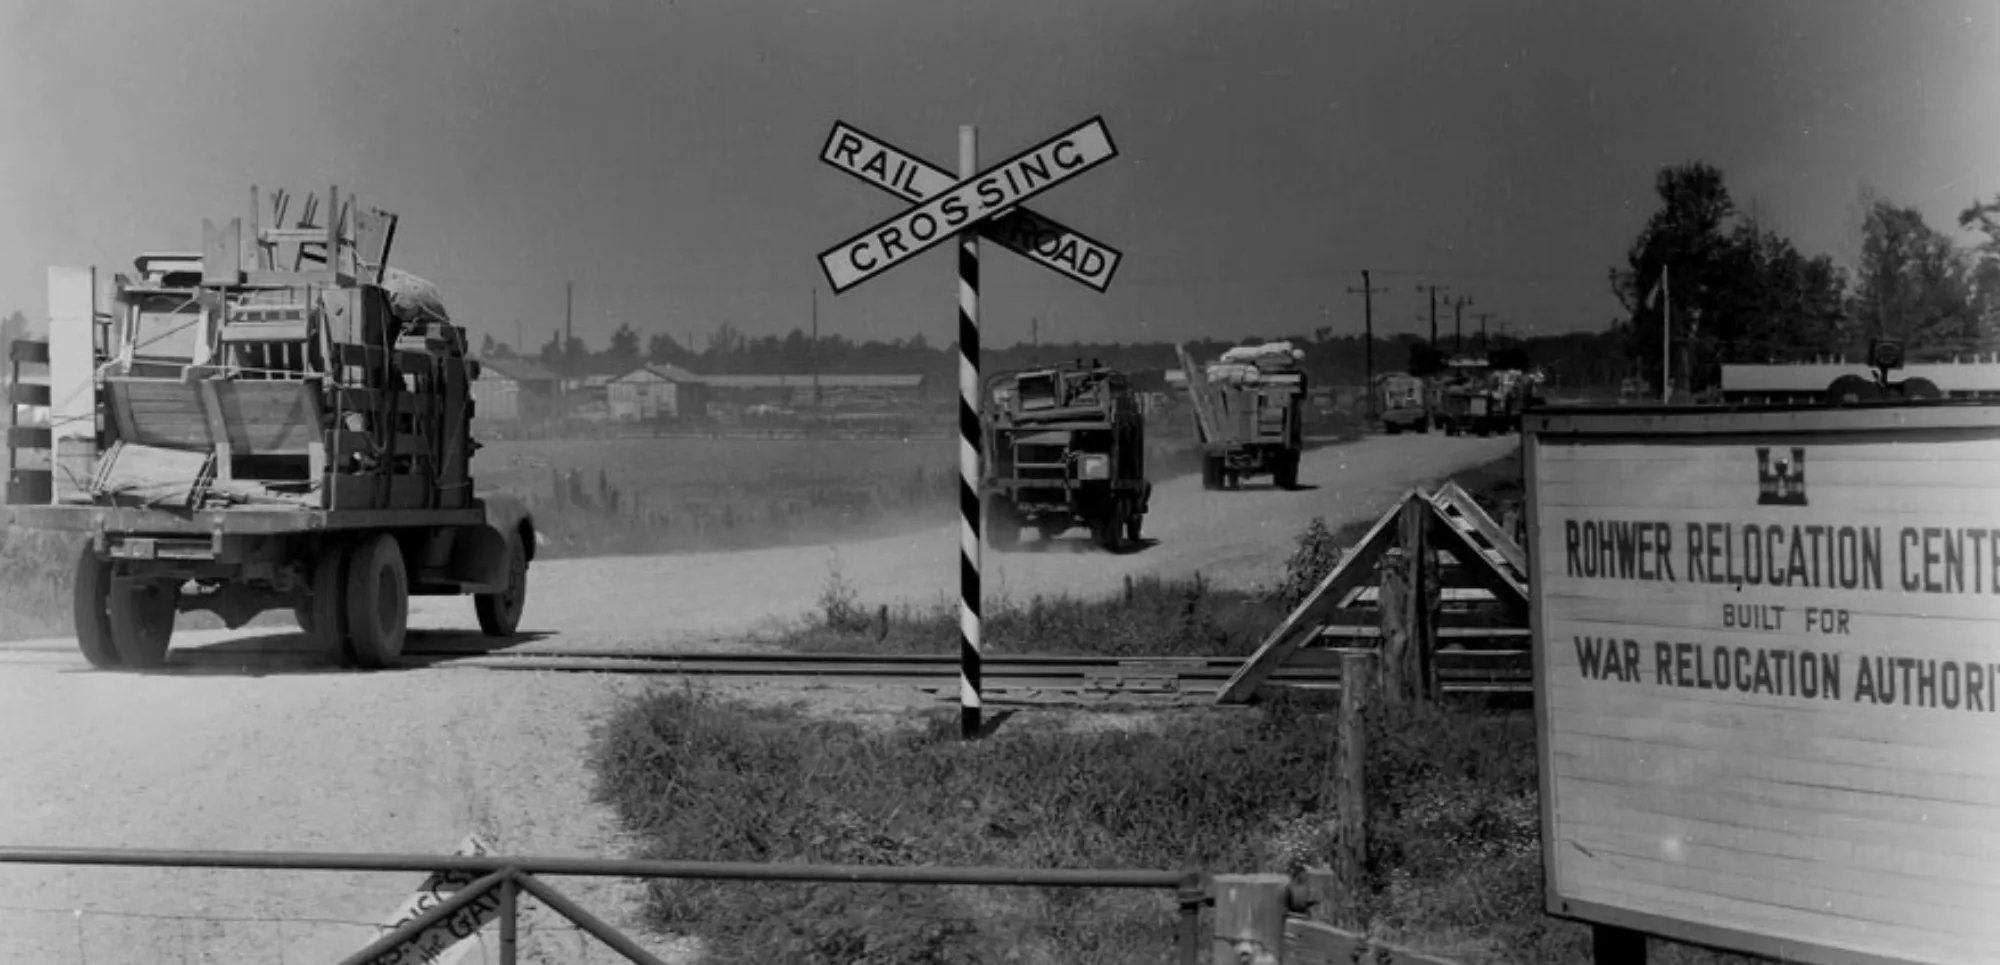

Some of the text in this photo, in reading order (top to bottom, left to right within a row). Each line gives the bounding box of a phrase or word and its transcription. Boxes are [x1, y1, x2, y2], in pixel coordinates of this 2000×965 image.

[833, 133, 1105, 277] RAIL ROAD
[850, 140, 1084, 271] CROSSING
[1564, 519, 1675, 581] ROHWER
[1686, 522, 1883, 590] RELOCATION
[1722, 604, 1850, 635] BUILT FOR
[1574, 636, 2000, 712] WAR RELOCATION AUTHORI
[447, 883, 501, 938] GAT
